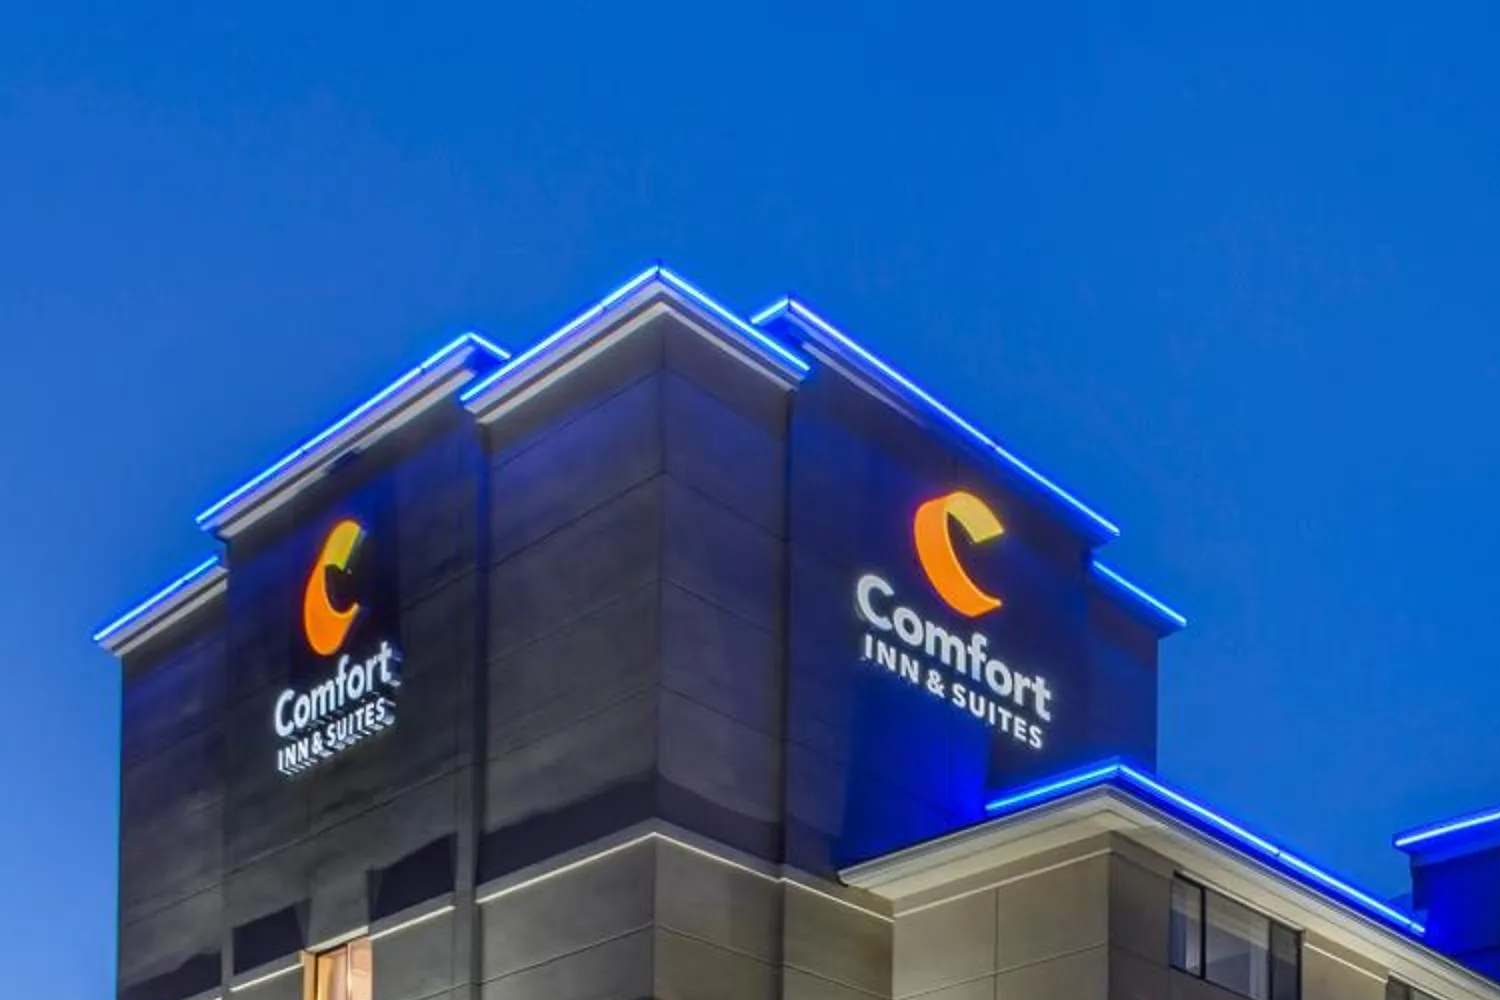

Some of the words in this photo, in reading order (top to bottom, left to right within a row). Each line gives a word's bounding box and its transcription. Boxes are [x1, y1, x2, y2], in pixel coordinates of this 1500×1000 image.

[275, 641, 392, 737] Comfort
[857, 574, 1052, 722] Comfort
[864, 633, 921, 685] INN
[926, 669, 946, 699] &
[951, 683, 1044, 750] SUITES
[278, 737, 309, 772] INN
[312, 731, 324, 755] &
[327, 697, 387, 748] SUITES
